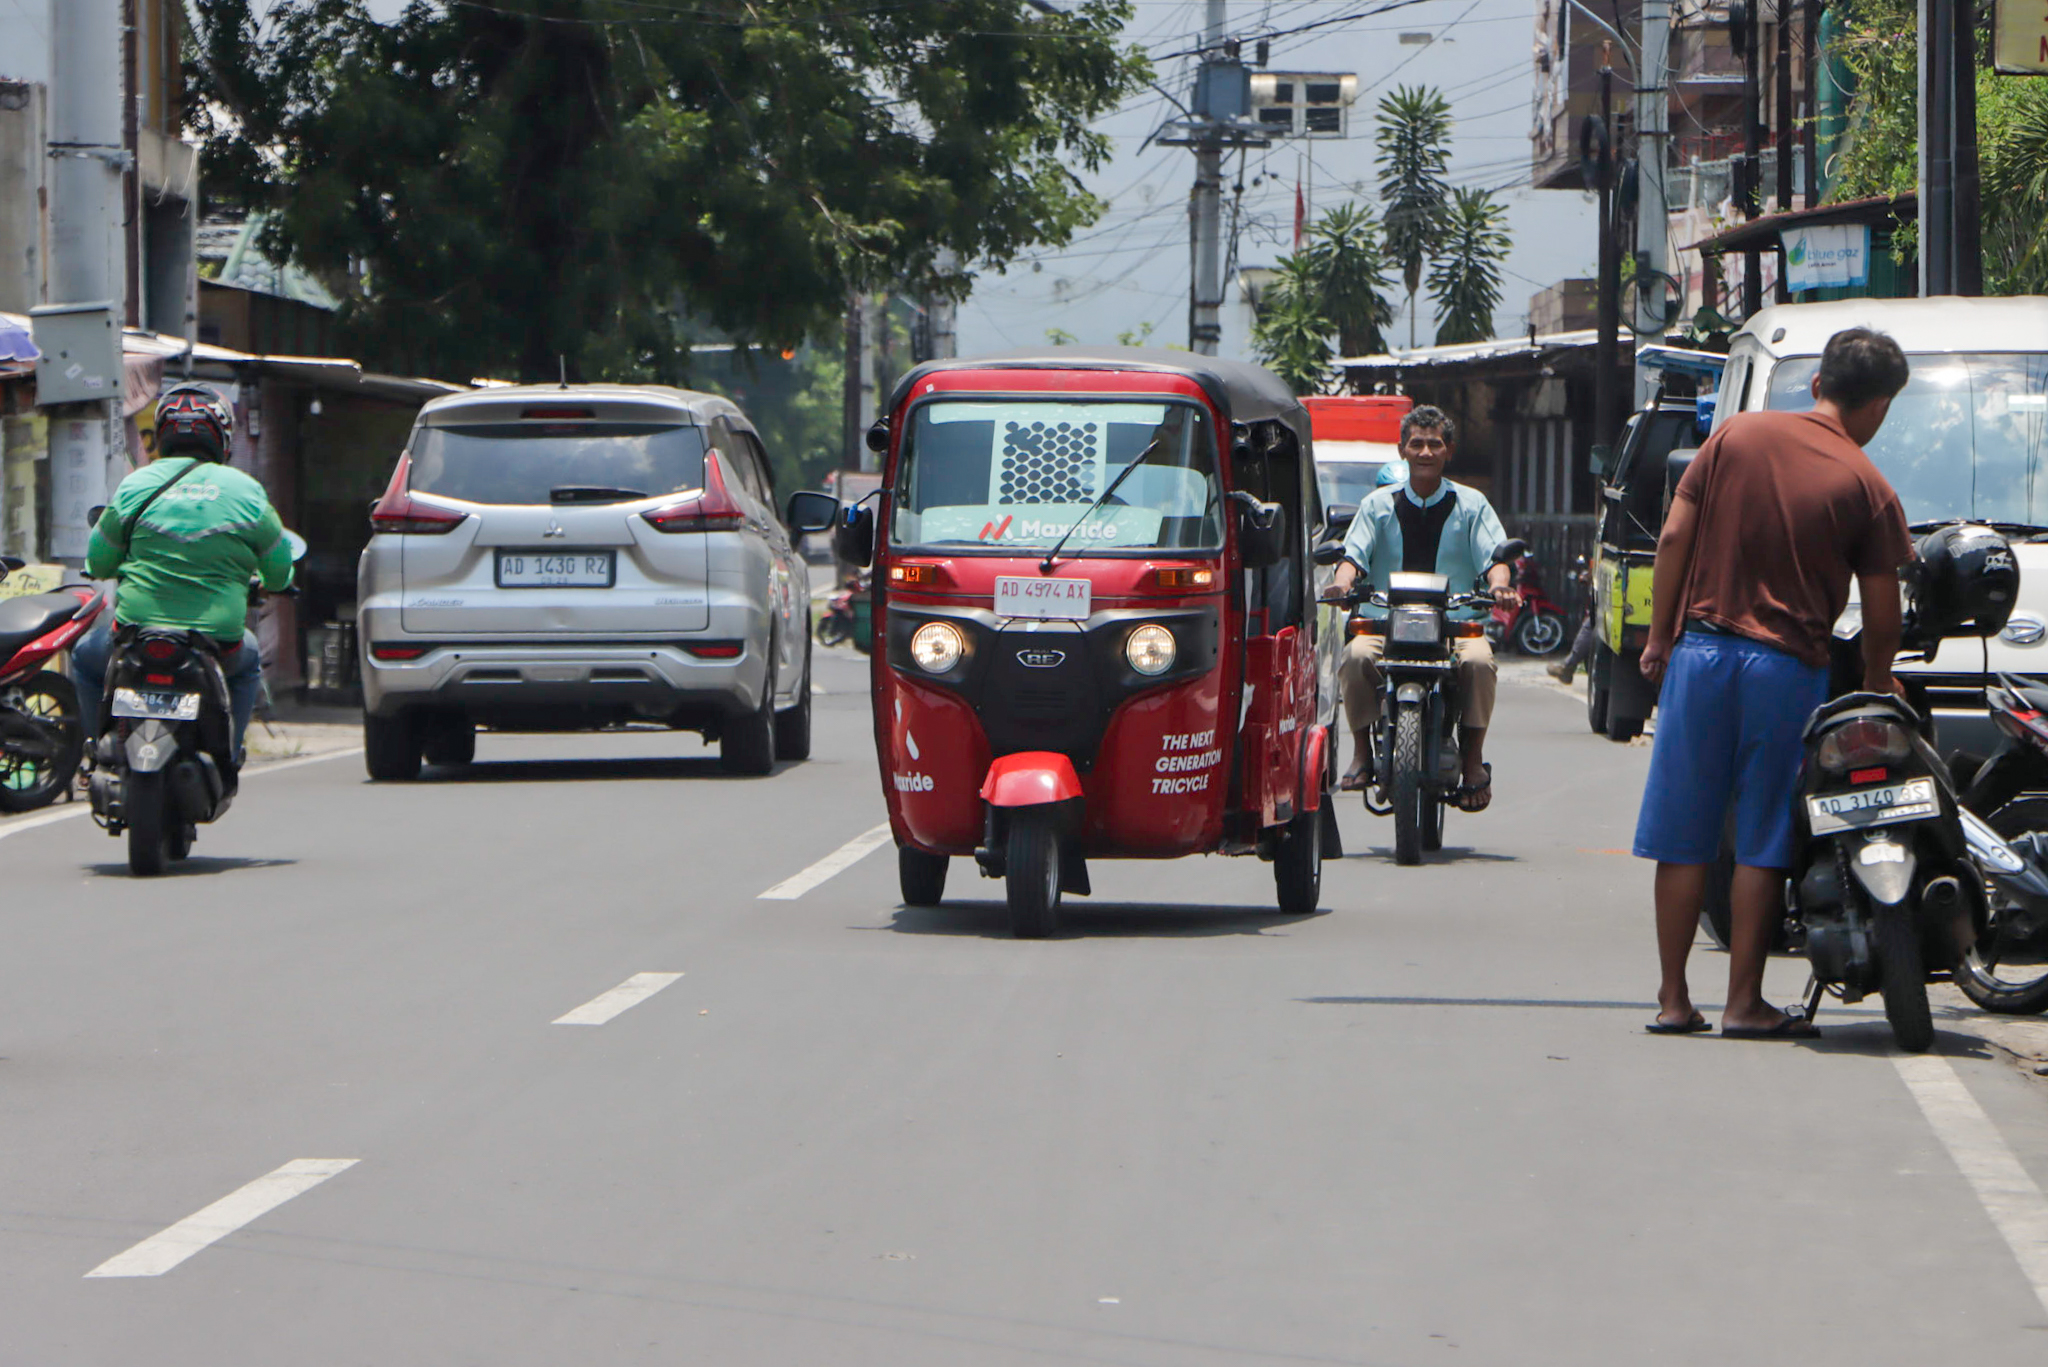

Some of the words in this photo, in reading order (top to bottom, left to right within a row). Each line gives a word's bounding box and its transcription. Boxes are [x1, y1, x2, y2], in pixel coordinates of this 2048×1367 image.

[1808, 249, 1835, 260] blue
[1837, 248, 1859, 261] gaz
[1021, 519, 1117, 539] Maxride
[504, 557, 524, 575] AD
[535, 557, 575, 575] 1430
[585, 557, 606, 575] RZ
[1001, 581, 1019, 597] AD
[1066, 583, 1085, 599] AX
[1027, 654, 1054, 664] RE
[1162, 734, 1189, 750] THE
[1189, 729, 1216, 749] NEXT
[1155, 748, 1222, 772] GENERATION
[1152, 773, 1209, 794] TRICYCLE
[1819, 799, 1842, 814] AD
[1849, 788, 1894, 811] 3140
